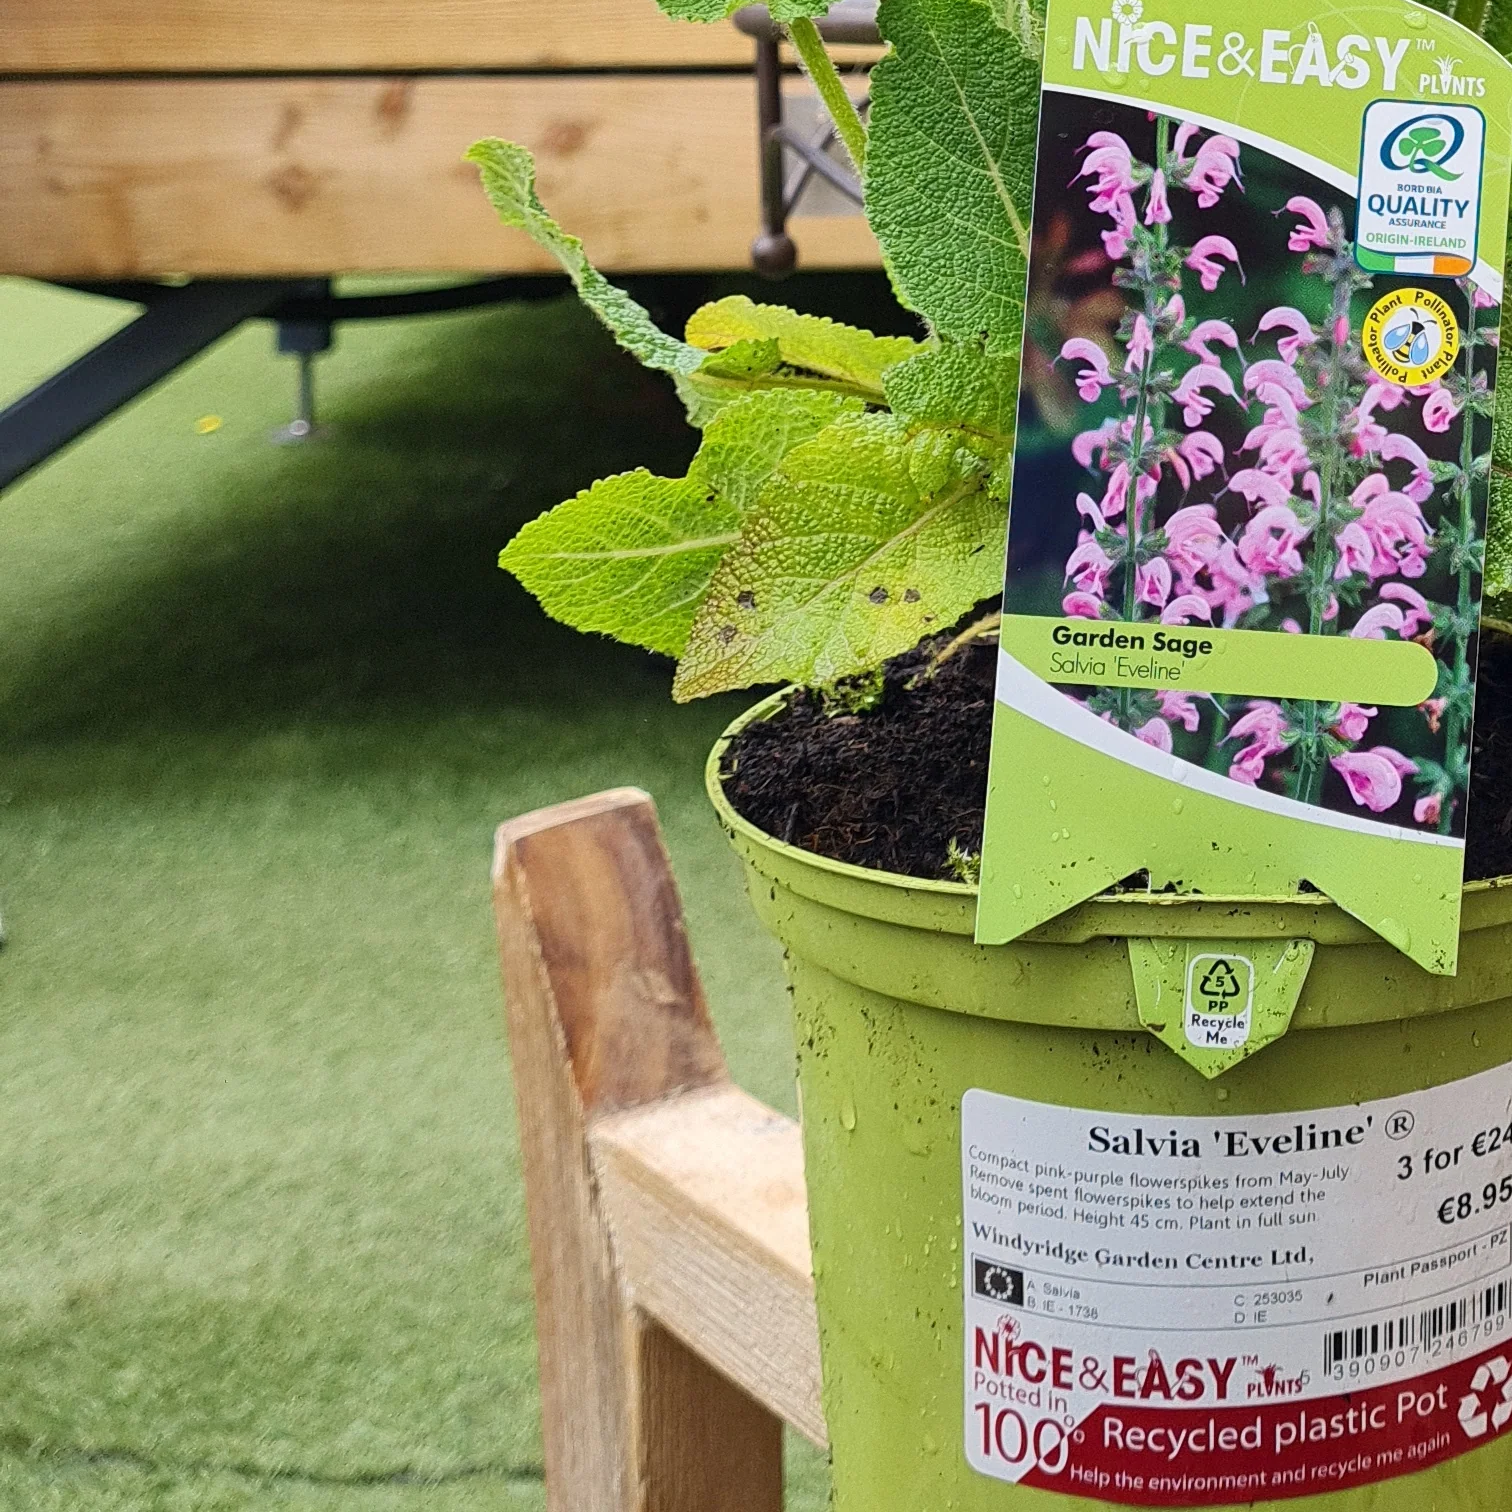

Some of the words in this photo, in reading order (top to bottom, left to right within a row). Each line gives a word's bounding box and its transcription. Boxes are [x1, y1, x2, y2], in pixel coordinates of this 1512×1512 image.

[1397, 183, 1424, 193] BORD
[1426, 185, 1443, 195] BIA
[1367, 193, 1470, 219] QUALITY
[1388, 217, 1446, 230] ASSURANCE
[1366, 232, 1467, 249] ORIGIN-IRELAND
[1370, 295, 1402, 323] Plant
[1414, 291, 1455, 348] Pollinator
[1368, 326, 1408, 383] Pollinator
[1420, 350, 1454, 379] Plant
[1052, 625, 1145, 650] Garden
[1152, 632, 1213, 659] Sage
[1049, 652, 1106, 676] Salvia
[1113, 655, 1185, 681] 'Eveline'
[1215, 976, 1225, 988] 5
[1208, 1000, 1229, 1012] PP
[1191, 1013, 1245, 1031] Recycle
[1206, 1031, 1227, 1044] Me
[1087, 1126, 1201, 1159] Salvia
[1214, 1114, 1374, 1158] 'Eveline'
[968, 1144, 1030, 1173] Compact
[1035, 1163, 1124, 1187] pink-purple
[1129, 1172, 1229, 1193] flowerspikes
[1235, 1174, 1273, 1188] from
[1279, 1163, 1349, 1187] May-July
[1396, 1155, 1413, 1180] 3
[1423, 1144, 1463, 1175] for
[969, 1164, 1024, 1192] Remove
[1028, 1183, 1069, 1201] spent
[1074, 1187, 1171, 1211] flowerspikes
[1176, 1196, 1193, 1210] to
[1199, 1194, 1235, 1212] help
[1239, 1191, 1294, 1208] extend
[1300, 1188, 1326, 1204] the
[970, 1184, 1012, 1209] bloom
[1017, 1200, 1068, 1220] period.
[1073, 1207, 1125, 1229] Height
[1130, 1214, 1150, 1229] 45
[1189, 1215, 1231, 1230] Plant
[1236, 1216, 1251, 1229] in
[1258, 1212, 1282, 1228] full
[972, 1222, 1089, 1265] Windyridge
[1094, 1248, 1178, 1269] Garden
[1185, 1252, 1263, 1270] Centre
[1363, 1263, 1406, 1288] Plant
[1410, 1244, 1478, 1277] Passport
[1490, 1229, 1509, 1253] PZ
[1026, 1279, 1036, 1291] A
[1043, 1282, 1081, 1300] Salvia
[1233, 1293, 1246, 1308] C
[1253, 1290, 1304, 1306] 253035
[1042, 1299, 1056, 1313] IE
[1234, 1311, 1246, 1324] D
[1253, 1310, 1268, 1323] IE
[1333, 1346, 1419, 1381] 390907
[1432, 1314, 1506, 1358] 246799
[975, 1370, 1041, 1407] Potted
[1102, 1415, 1262, 1459] Recycled
[1275, 1402, 1386, 1454] plastic
[1397, 1384, 1450, 1424] Pot
[1070, 1463, 1110, 1488] Help
[1114, 1470, 1144, 1490] the
[1148, 1470, 1267, 1493] environment
[1271, 1463, 1306, 1486] and
[1311, 1452, 1372, 1480] recycle
[1376, 1445, 1403, 1468] me
[1407, 1430, 1451, 1461] again
